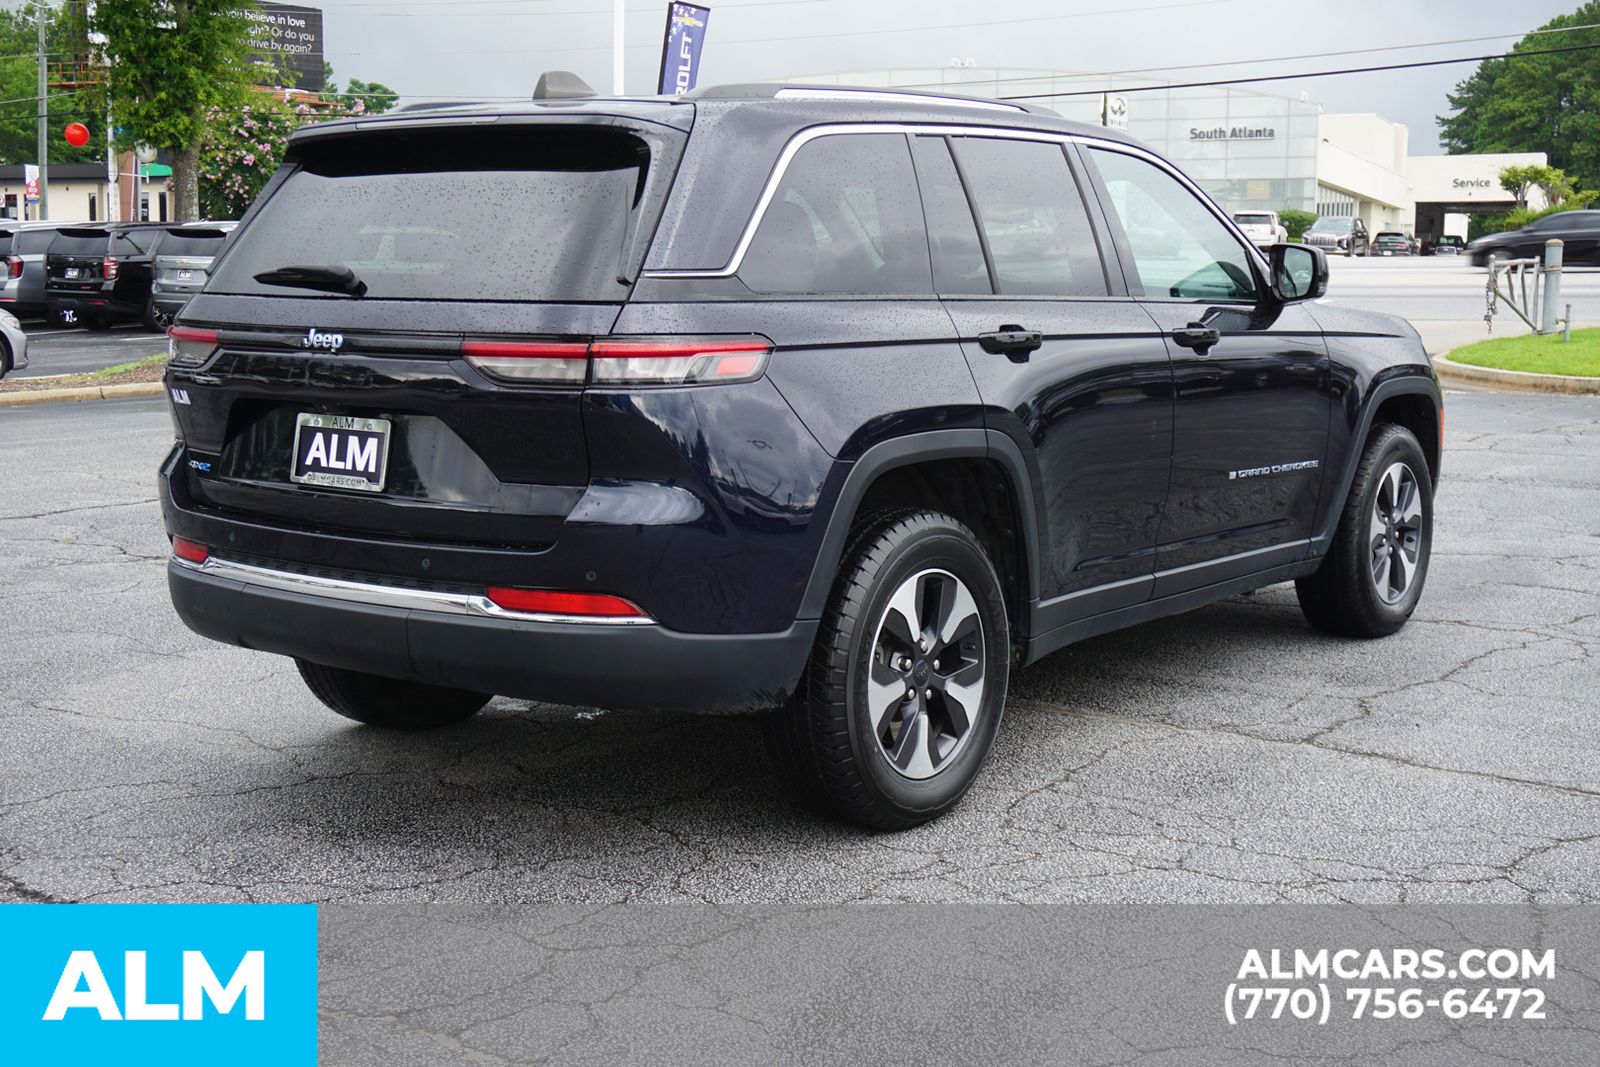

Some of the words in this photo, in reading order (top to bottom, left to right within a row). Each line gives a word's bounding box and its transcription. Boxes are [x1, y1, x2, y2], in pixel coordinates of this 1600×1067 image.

[244, 9, 276, 24] believe
[277, 15, 286, 25] in
[287, 15, 306, 28] love
[271, 26, 283, 38] Or
[285, 28, 297, 39] do
[298, 32, 315, 42] you
[247, 38, 269, 49] drive
[283, 43, 312, 54] again?
[1189, 127, 1226, 140] South
[1229, 126, 1275, 138] Atlanta
[1453, 178, 1491, 188] Service
[303, 328, 344, 353] Jeep
[171, 388, 192, 405] ALM
[331, 416, 355, 430] ALM
[304, 431, 379, 473] ALM
[1238, 466, 1271, 478] GRAND
[1271, 459, 1320, 474] CHEROKEE
